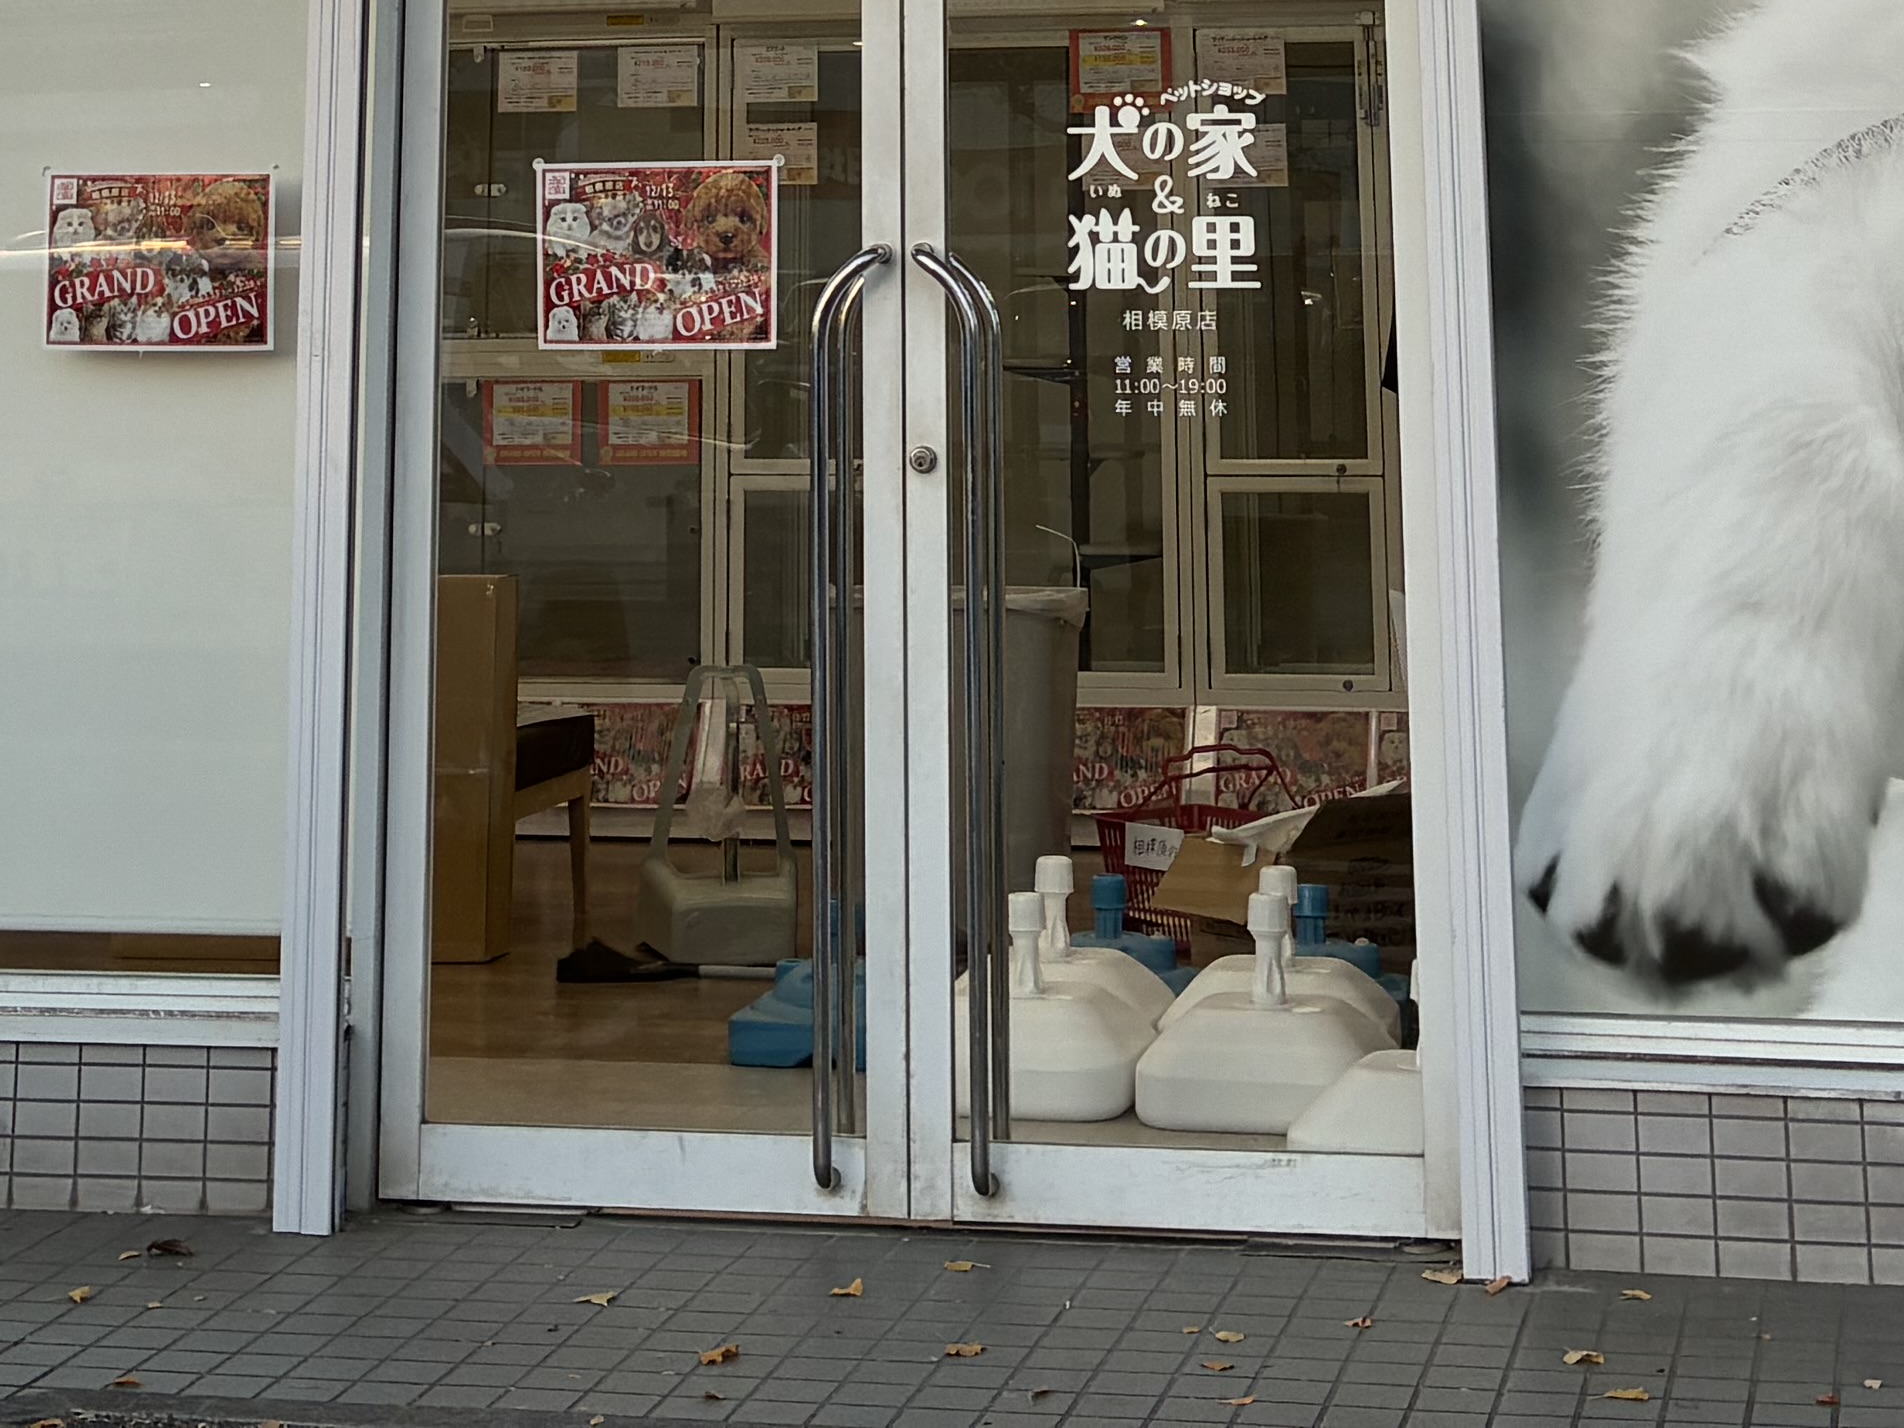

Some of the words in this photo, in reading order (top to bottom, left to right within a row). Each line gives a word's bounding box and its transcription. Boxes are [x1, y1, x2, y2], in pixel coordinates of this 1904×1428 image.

[1066, 93, 1258, 181] 犬の家
[1089, 184, 1123, 199] いぬ
[1152, 175, 1185, 215] &
[1206, 192, 1240, 209] ねこ
[1066, 207, 1262, 295] 猫の里
[53, 267, 155, 309] GRAND
[549, 262, 654, 306] GRAND
[172, 291, 260, 340] OPEN
[675, 288, 764, 337] OPEN
[1122, 310, 1217, 332] 相模原店
[1114, 356, 1227, 375] 営業時間
[1114, 399, 1228, 417] 年中無休
